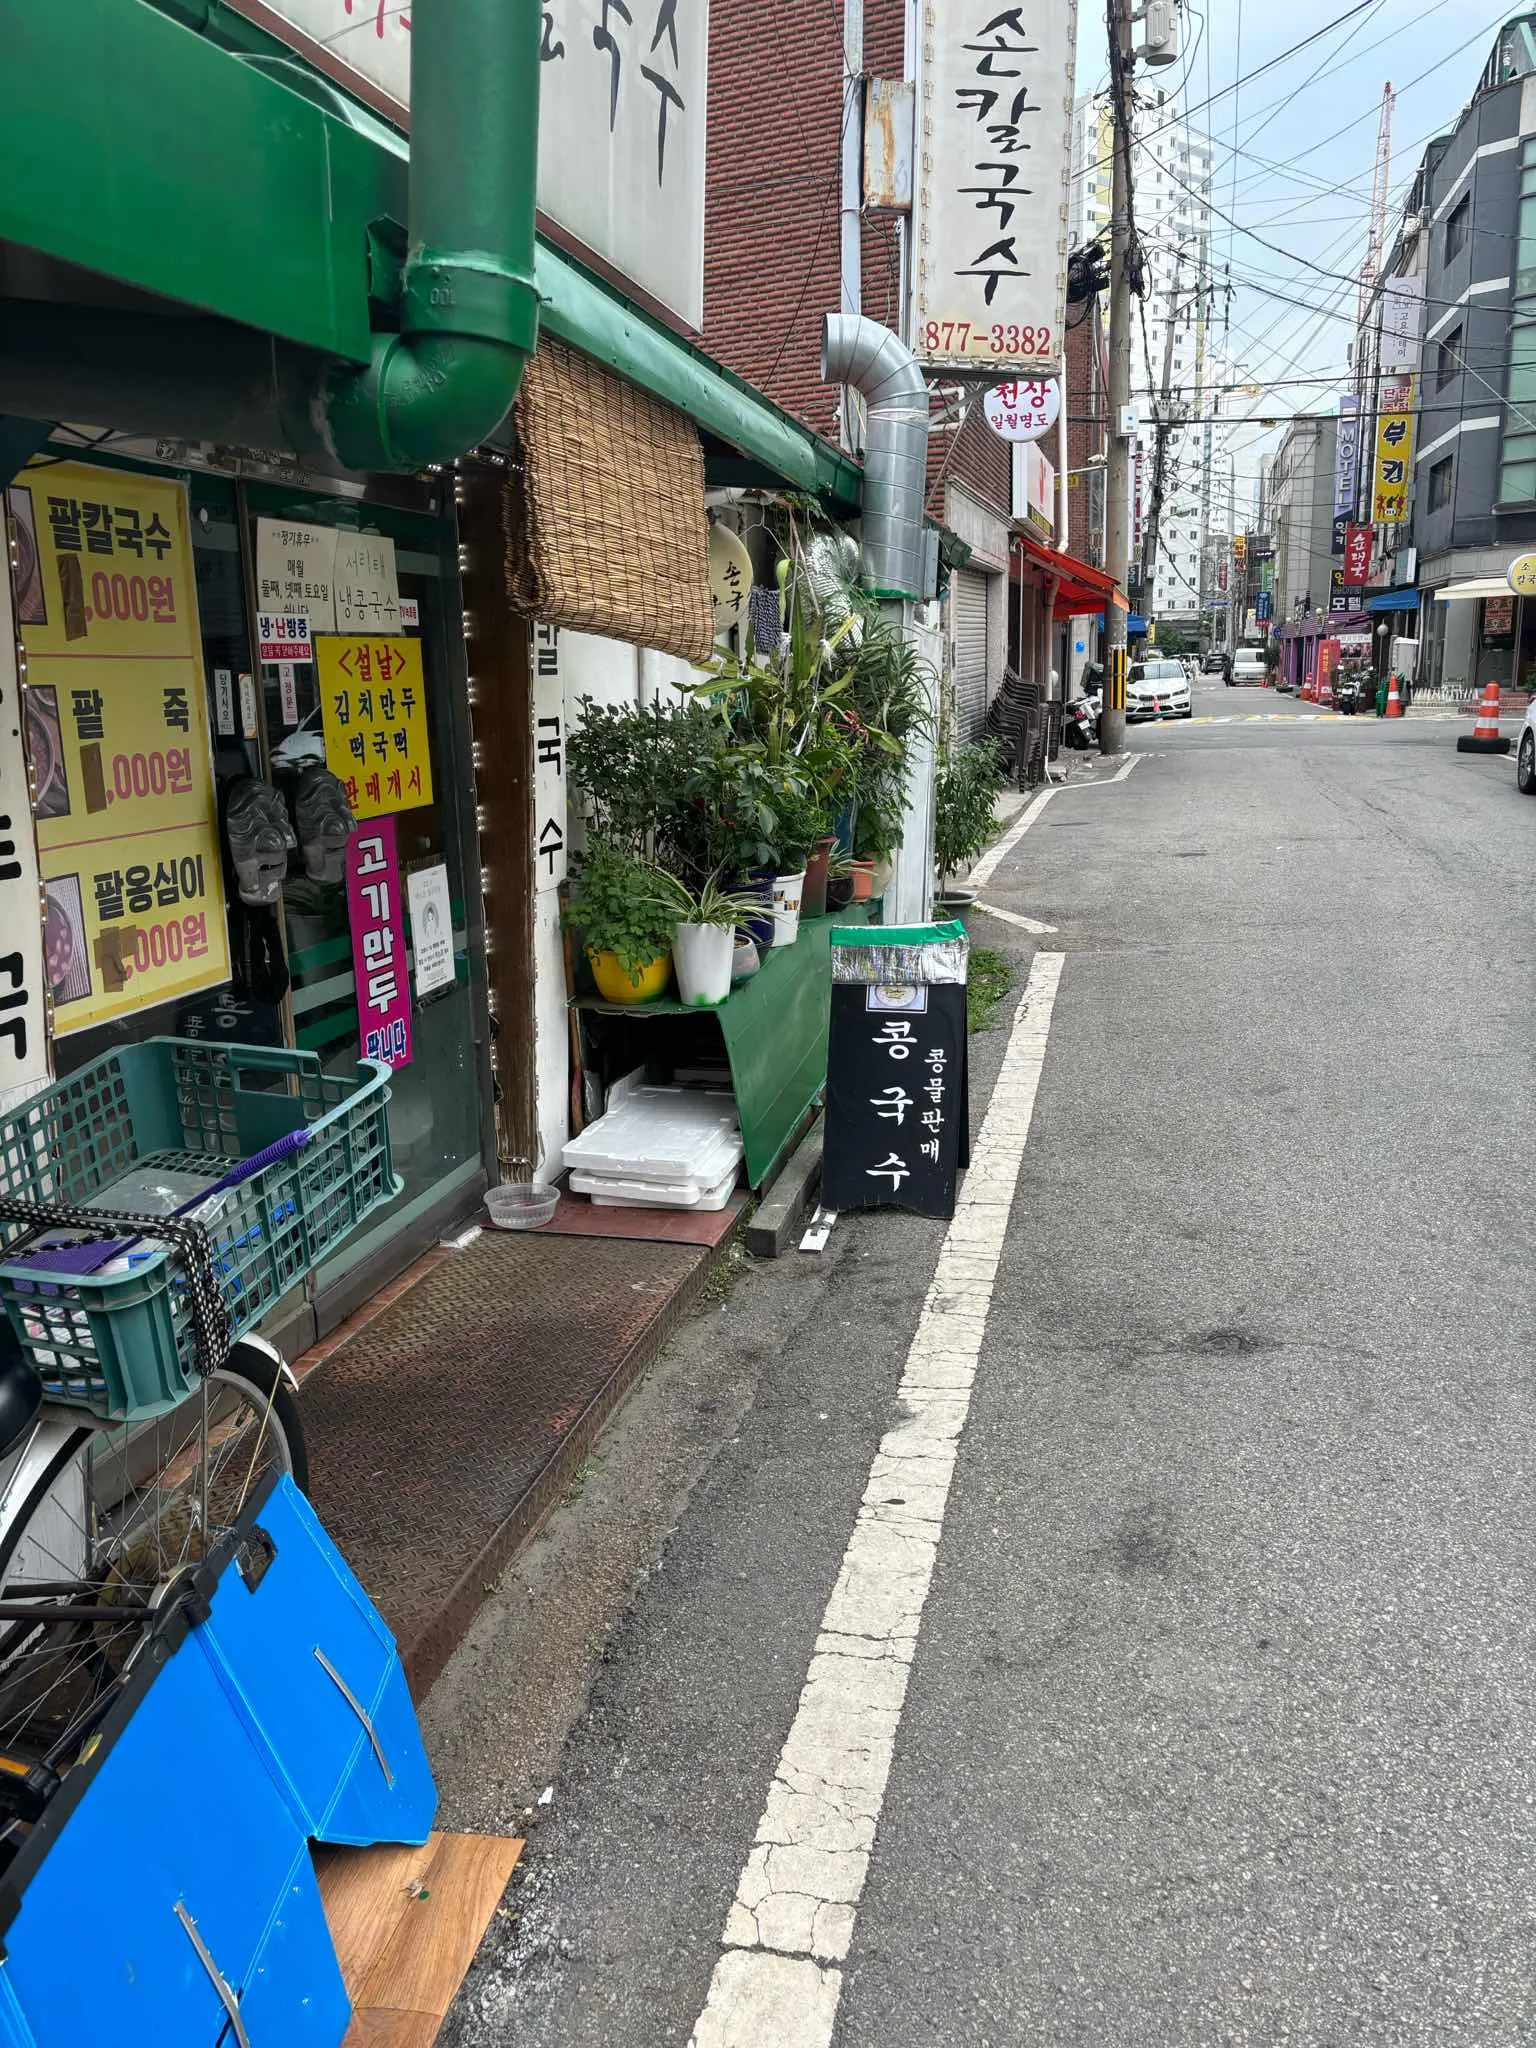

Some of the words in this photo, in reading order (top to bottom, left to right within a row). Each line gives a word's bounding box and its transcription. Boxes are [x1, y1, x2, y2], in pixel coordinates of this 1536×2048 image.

[954, 7, 1041, 306] 손칼국수
[925, 320, 1051, 357] 877-3382
[992, 379, 1052, 410] 천상
[990, 412, 1049, 430] 일월명도
[1339, 428, 1356, 508] MOTEL
[1382, 420, 1407, 483] 부킹
[47, 496, 172, 560] 팥칼국수
[287, 559, 304, 578] 매월
[305, 583, 329, 601] 토요일
[339, 586, 397, 624] 냉콩국수
[1331, 597, 1361, 611] 모텔
[334, 687, 416, 726] 김치만두
[349, 728, 409, 767] 떡국떡
[343, 765, 423, 810] 판매개시
[93, 854, 205, 921] 팥옹심이
[357, 835, 399, 1014] 고기만두
[865, 1020, 918, 1192] 콩국수
